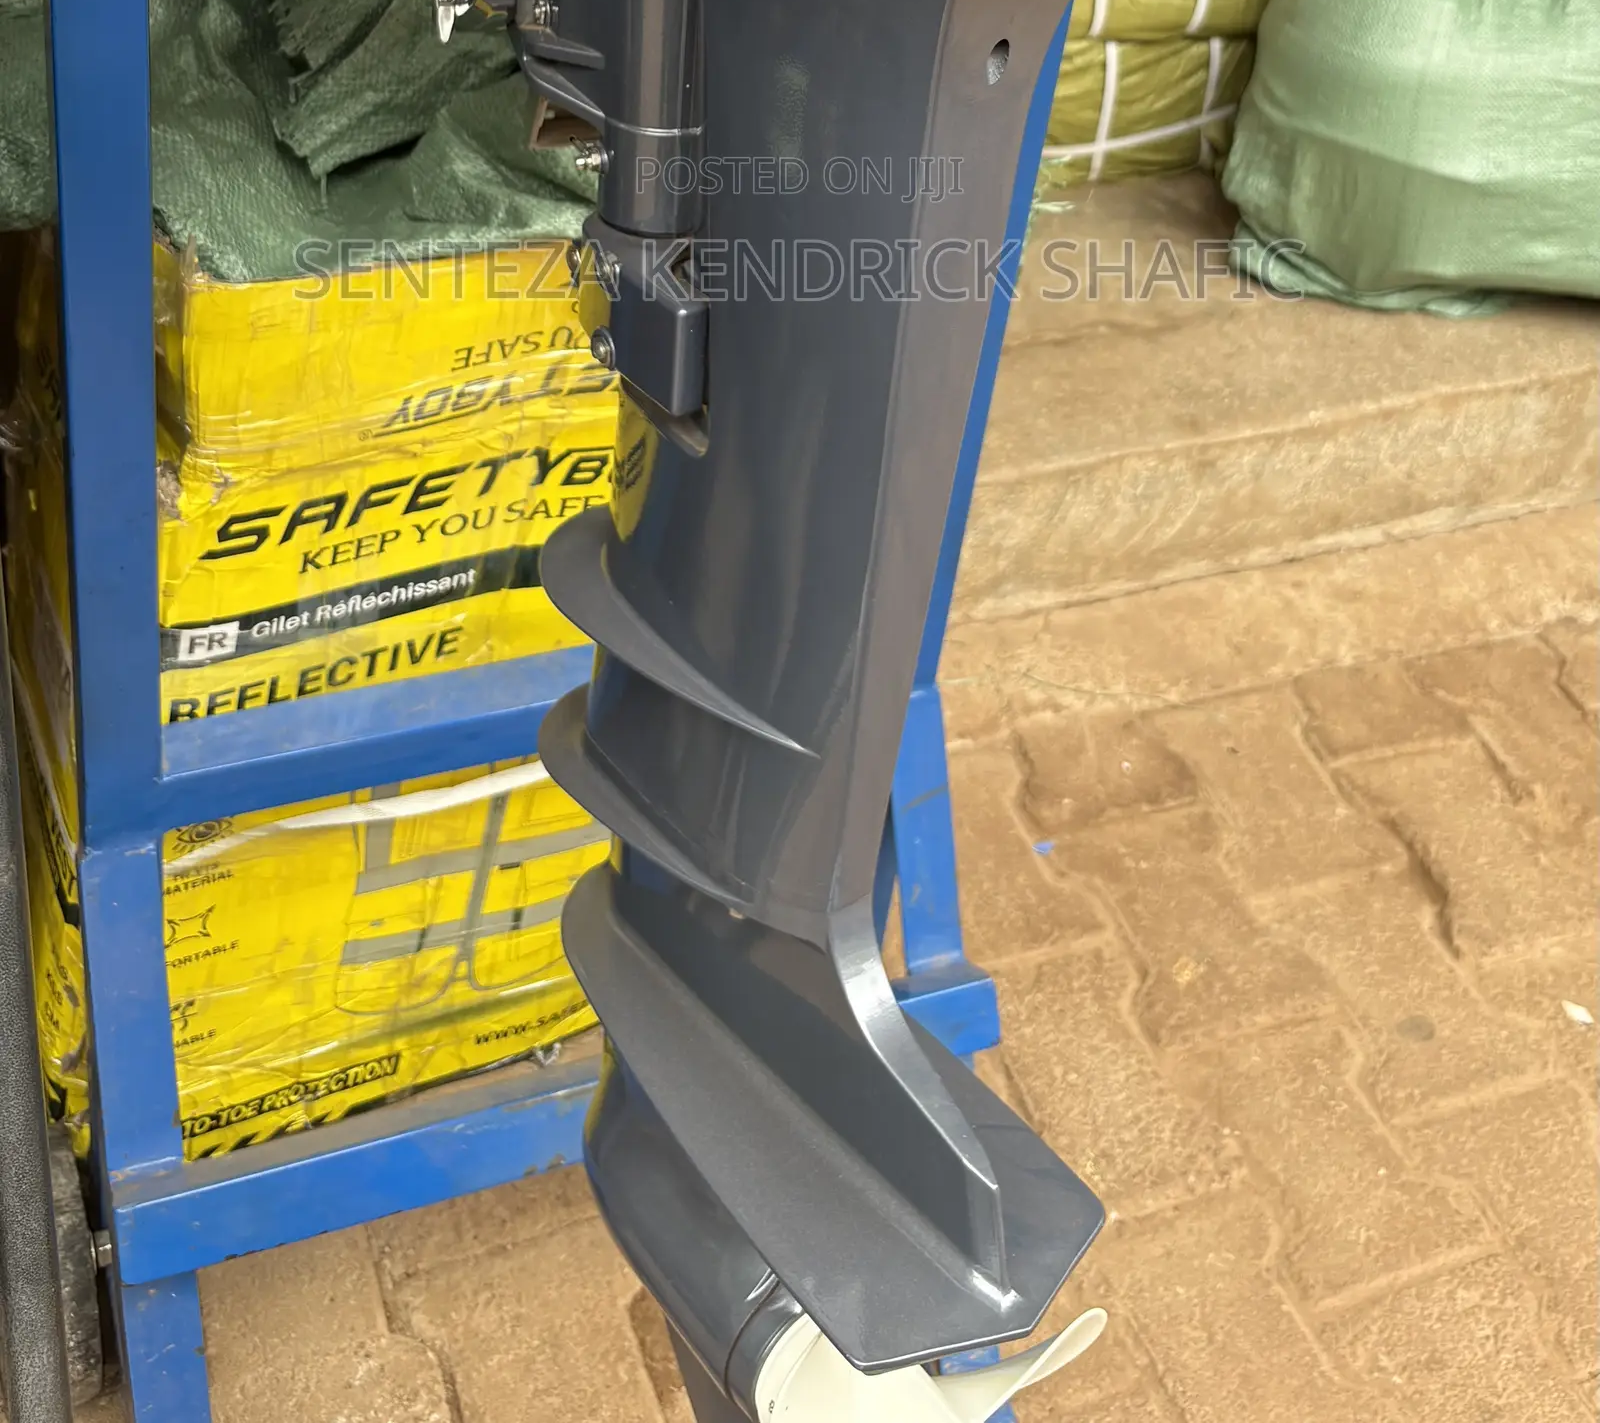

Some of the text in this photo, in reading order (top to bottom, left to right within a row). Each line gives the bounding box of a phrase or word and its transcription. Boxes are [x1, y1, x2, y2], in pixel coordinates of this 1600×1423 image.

[450, 330, 544, 373] SAFE
[198, 445, 614, 561] SAFETYB
[299, 528, 400, 574] KEEP
[413, 504, 496, 544] YOU
[187, 567, 478, 655] FR Gilet Réfléchissant
